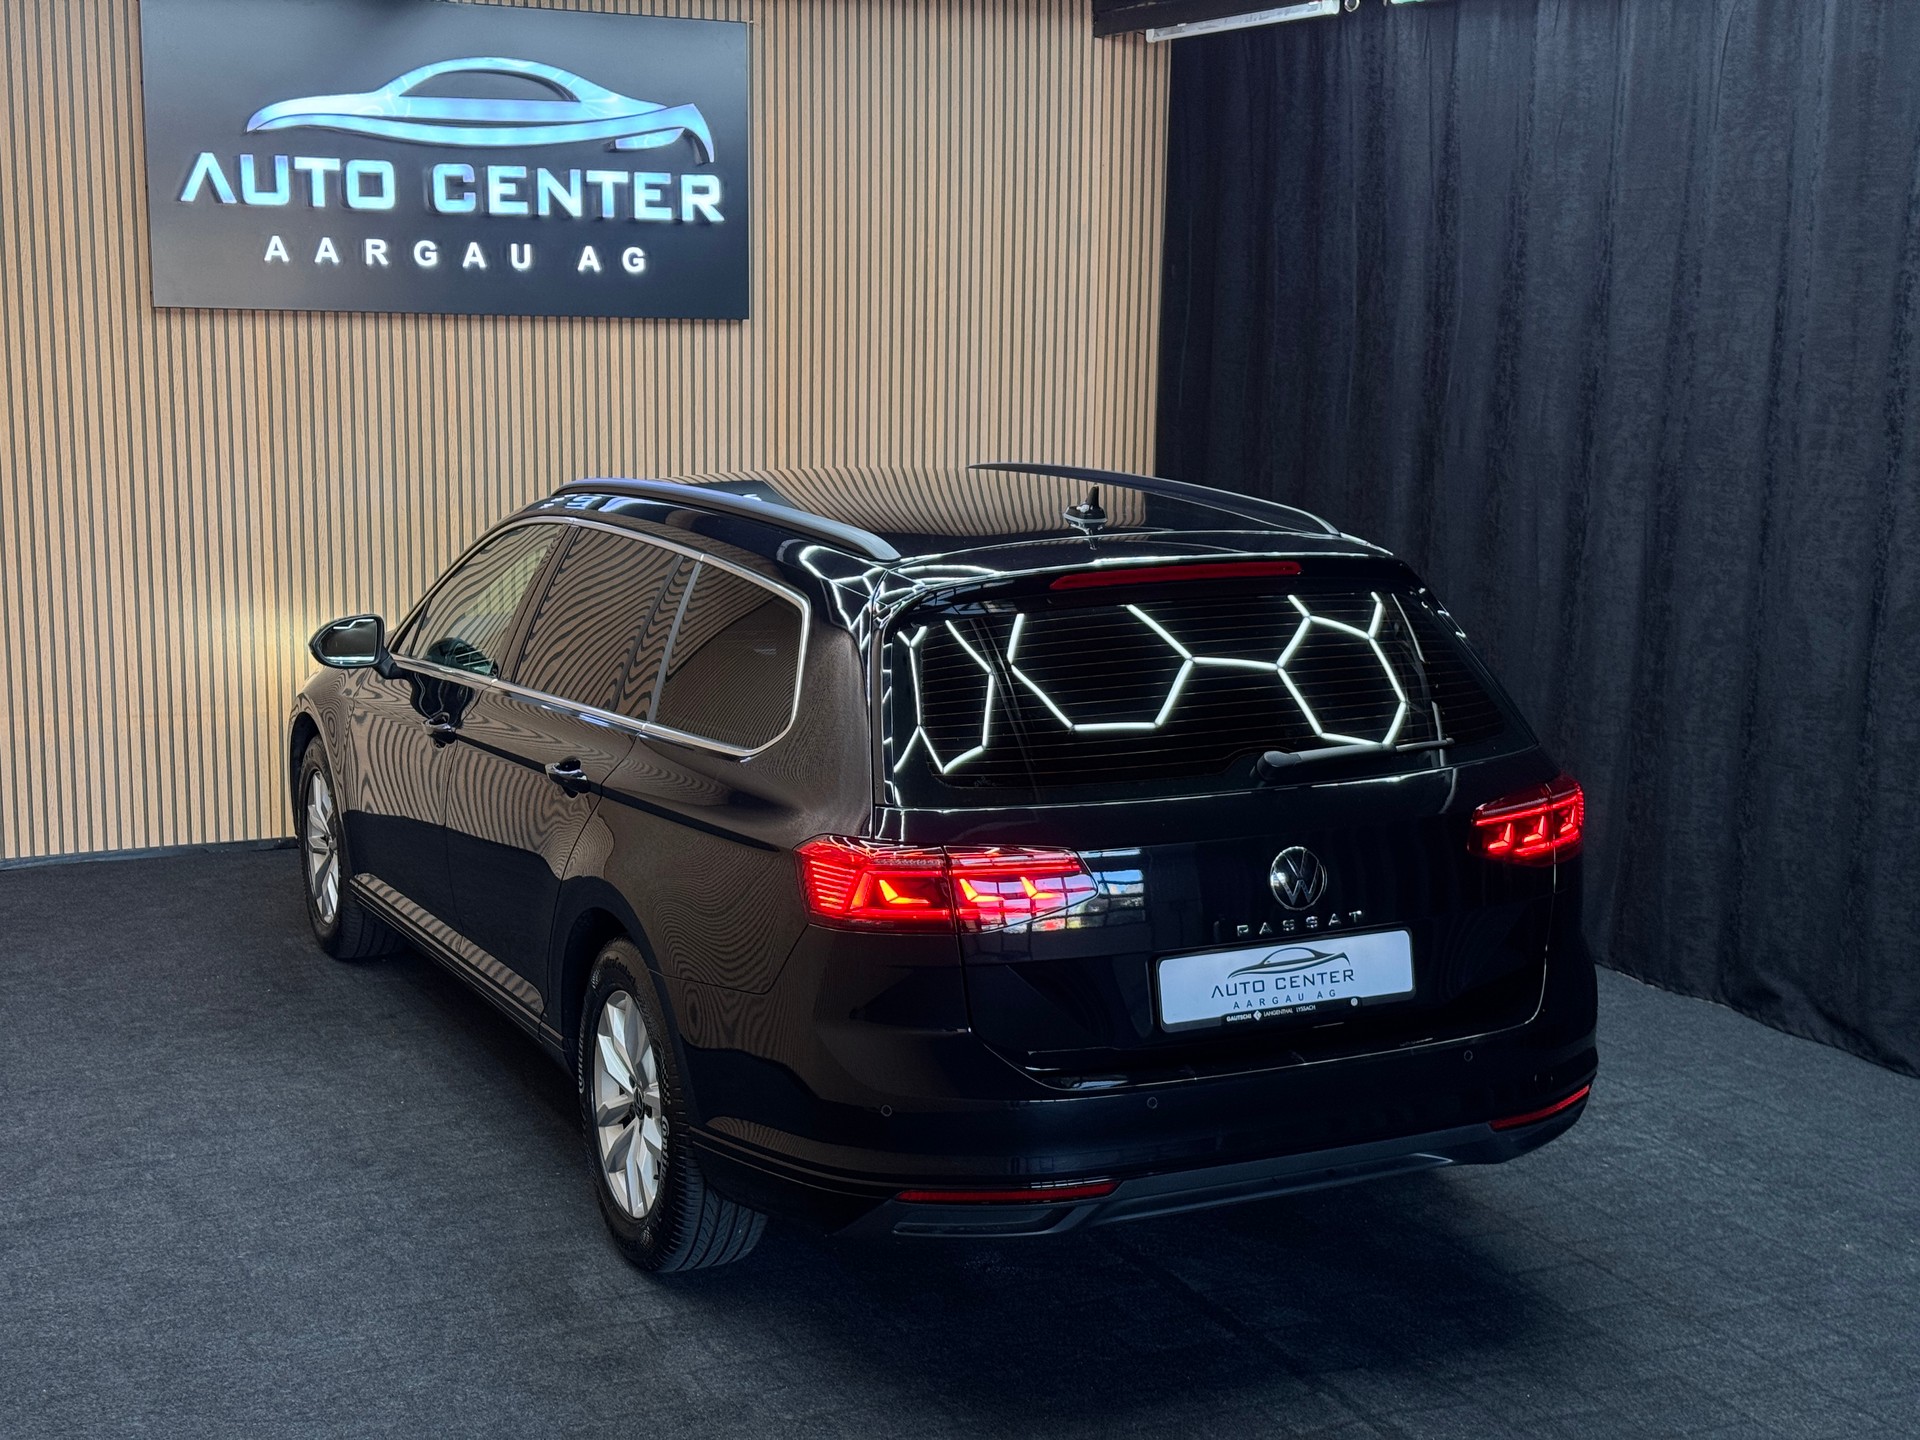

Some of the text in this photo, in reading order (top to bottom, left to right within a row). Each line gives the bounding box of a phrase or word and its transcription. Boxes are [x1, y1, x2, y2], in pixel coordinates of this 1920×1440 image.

[180, 152, 725, 222] AUTO CENTER
[264, 235, 647, 273] AARGAU AG
[1236, 910, 1363, 937] PASSAT
[1211, 969, 1355, 998] AUTO CENTER
[1233, 989, 1336, 1010] AARGAU AG
